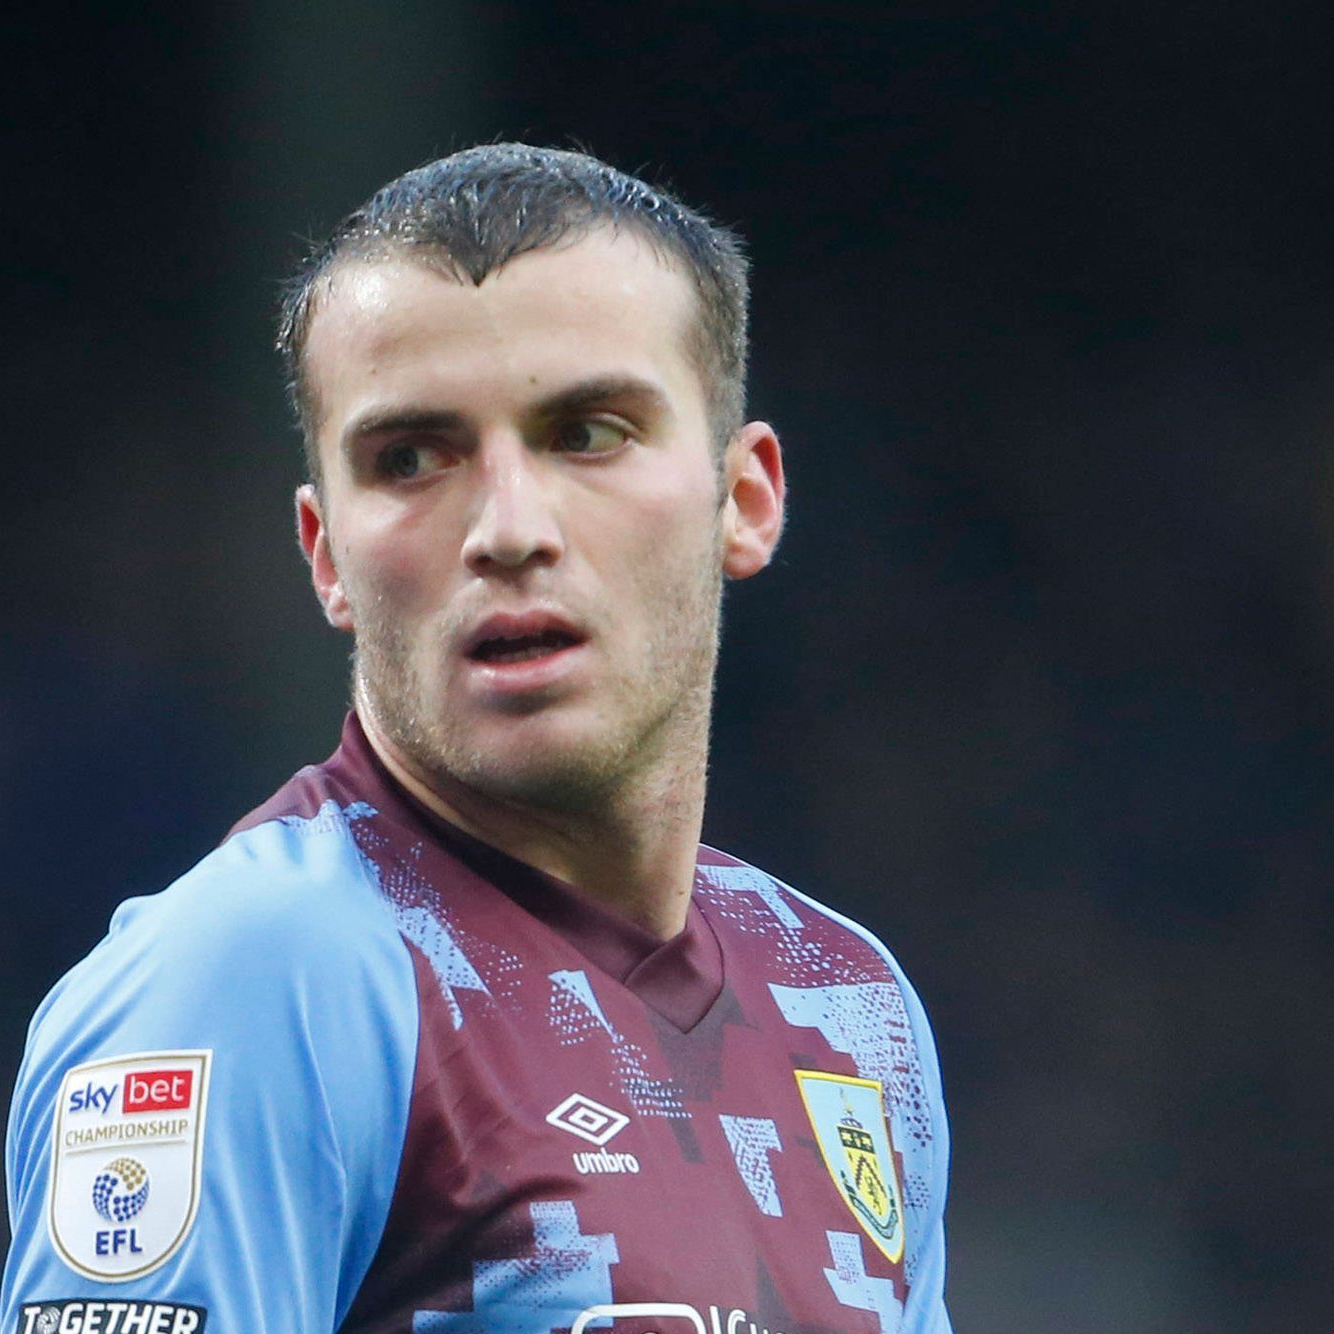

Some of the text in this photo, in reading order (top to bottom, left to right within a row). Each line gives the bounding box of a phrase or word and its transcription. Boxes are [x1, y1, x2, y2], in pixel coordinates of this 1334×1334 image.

[69, 1074, 184, 1115] sky bet
[65, 1118, 189, 1146] CHAMPIONSHIP
[573, 1148, 640, 1175] umbro
[95, 1228, 143, 1256] EFL
